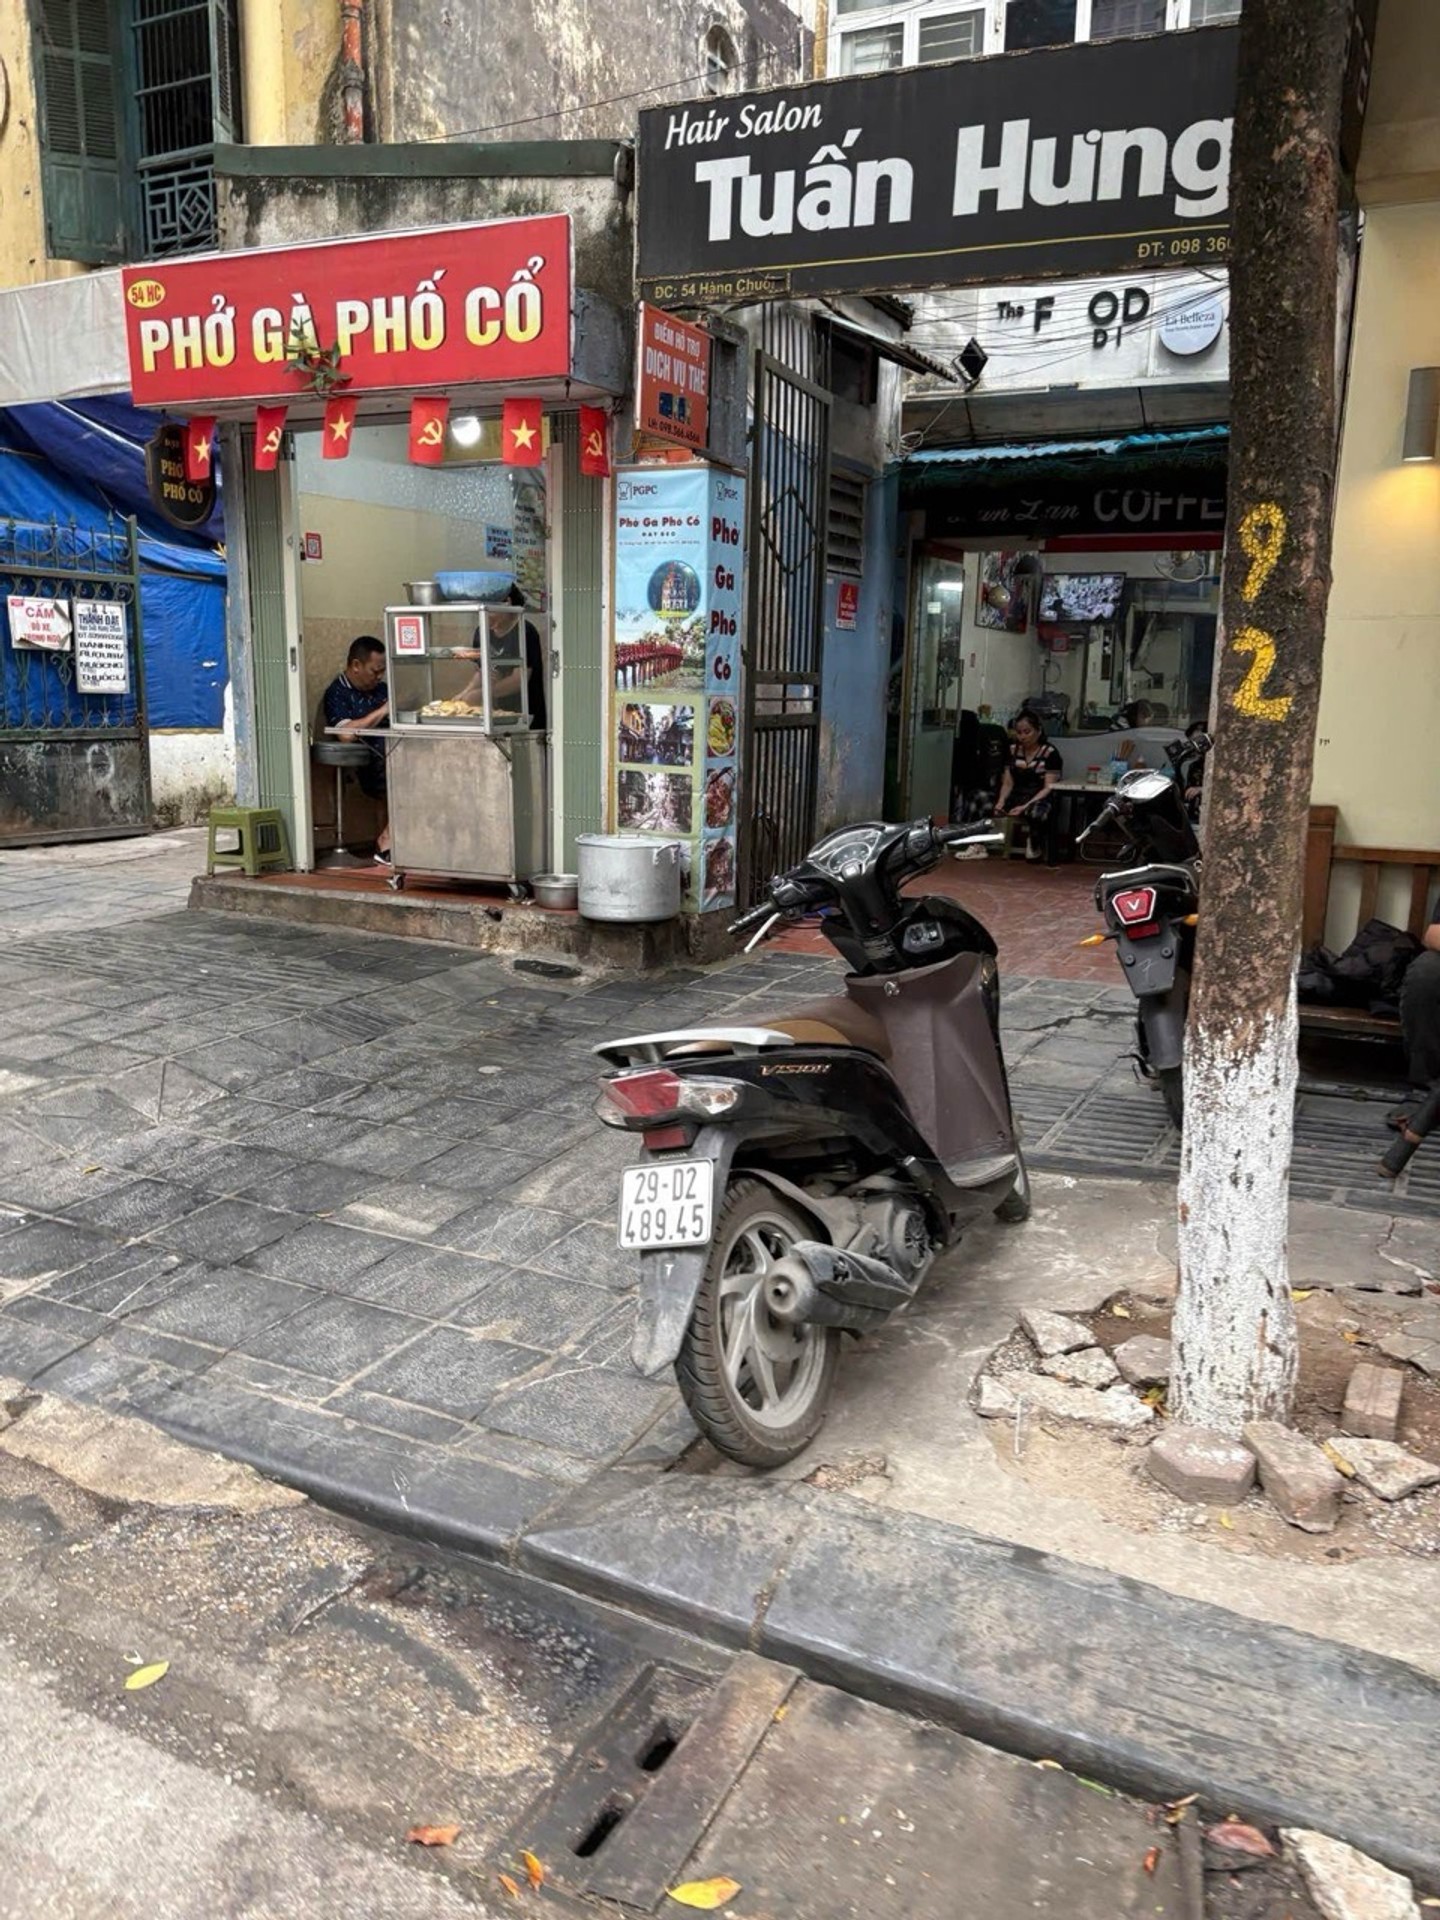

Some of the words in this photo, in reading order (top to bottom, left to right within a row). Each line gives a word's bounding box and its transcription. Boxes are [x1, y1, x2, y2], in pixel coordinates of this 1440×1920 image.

[664, 110, 730, 150] Hair
[735, 100, 823, 138] Salon
[695, 128, 914, 242] Tuấn
[952, 117, 1235, 218] Hưng
[1137, 241, 1165, 258] ĐT:
[1170, 238, 1200, 255] 098
[1205, 236, 1231, 252] 36
[131, 285, 145, 303] 54
[148, 284, 162, 302] HC
[654, 285, 677, 299] ĐC:
[681, 283, 696, 297] 54
[140, 294, 236, 373] PHỞ
[252, 292, 321, 364] GÀ
[336, 269, 447, 357] PHỐ
[465, 255, 545, 346] CỔ
[997, 300, 1024, 319] The
[646, 346, 671, 382] DỊCH
[674, 358, 686, 393] VỤ
[688, 361, 706, 395] THẺ
[632, 484, 658, 496] PGPC
[712, 516, 740, 546] Phở
[26, 602, 55, 619] CẤM
[710, 610, 737, 637] Phố
[760, 1063, 832, 1076] VISION
[633, 1166, 698, 1205] 29-D2
[625, 1204, 705, 1243] 489.45
